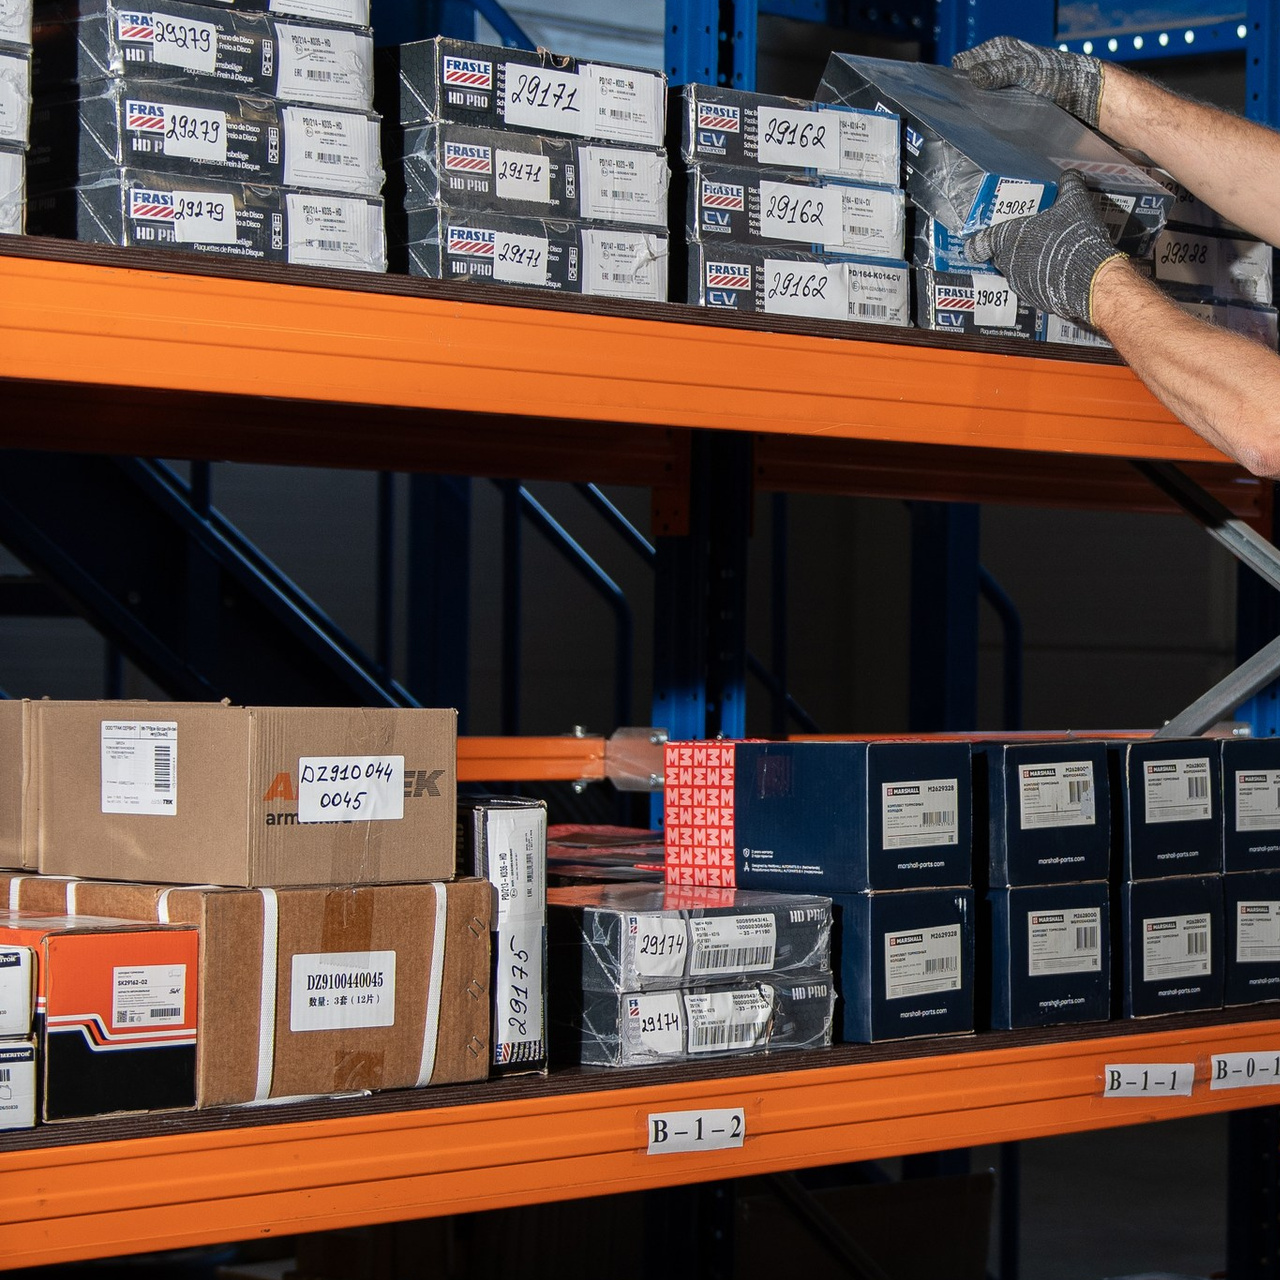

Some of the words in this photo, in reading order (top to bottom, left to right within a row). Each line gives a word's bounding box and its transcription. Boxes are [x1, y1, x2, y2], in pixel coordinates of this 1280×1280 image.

[155, 21, 210, 52] 29279
[446, 59, 490, 74] FRASLE
[448, 91, 463, 105] HD
[467, 94, 488, 108] PRO
[512, 74, 580, 111] 29171
[700, 105, 738, 118] FRASLE
[166, 115, 220, 143] 29279
[764, 117, 826, 149] 29162
[446, 144, 490, 159] FRASLE
[498, 161, 541, 183] 29171
[450, 177, 464, 190] HD
[467, 179, 489, 193] PRO
[174, 198, 225, 221] 29279
[767, 195, 824, 226] 29162
[996, 199, 1035, 215] 29087
[450, 229, 495, 243] FRASLE
[498, 242, 541, 268] 29171
[1161, 241, 1208, 264] 29228
[452, 261, 467, 275] HD
[469, 263, 492, 276] PRO
[709, 264, 749, 277] FRASLE
[768, 272, 828, 299] 29162
[938, 288, 974, 299] FRASLE
[976, 290, 1009, 307] 29087
[320, 791, 367, 810] 0045
[1038, 856, 1085, 864] marshall-parts.com
[1157, 851, 1199, 860] marshall-parts.com
[898, 861, 945, 869] marshall-parts.com
[640, 935, 684, 956] 29174
[307, 972, 383, 990] DZ9100440045
[508, 935, 529, 1036] 29175
[792, 987, 806, 1000] HD
[808, 985, 826, 998] PRO
[1158, 987, 1201, 997] marshall-parts.com
[1039, 997, 1085, 1007] marshall-parts.com
[900, 1008, 947, 1018] marshall-parts.com
[642, 1013, 679, 1033] 29174
